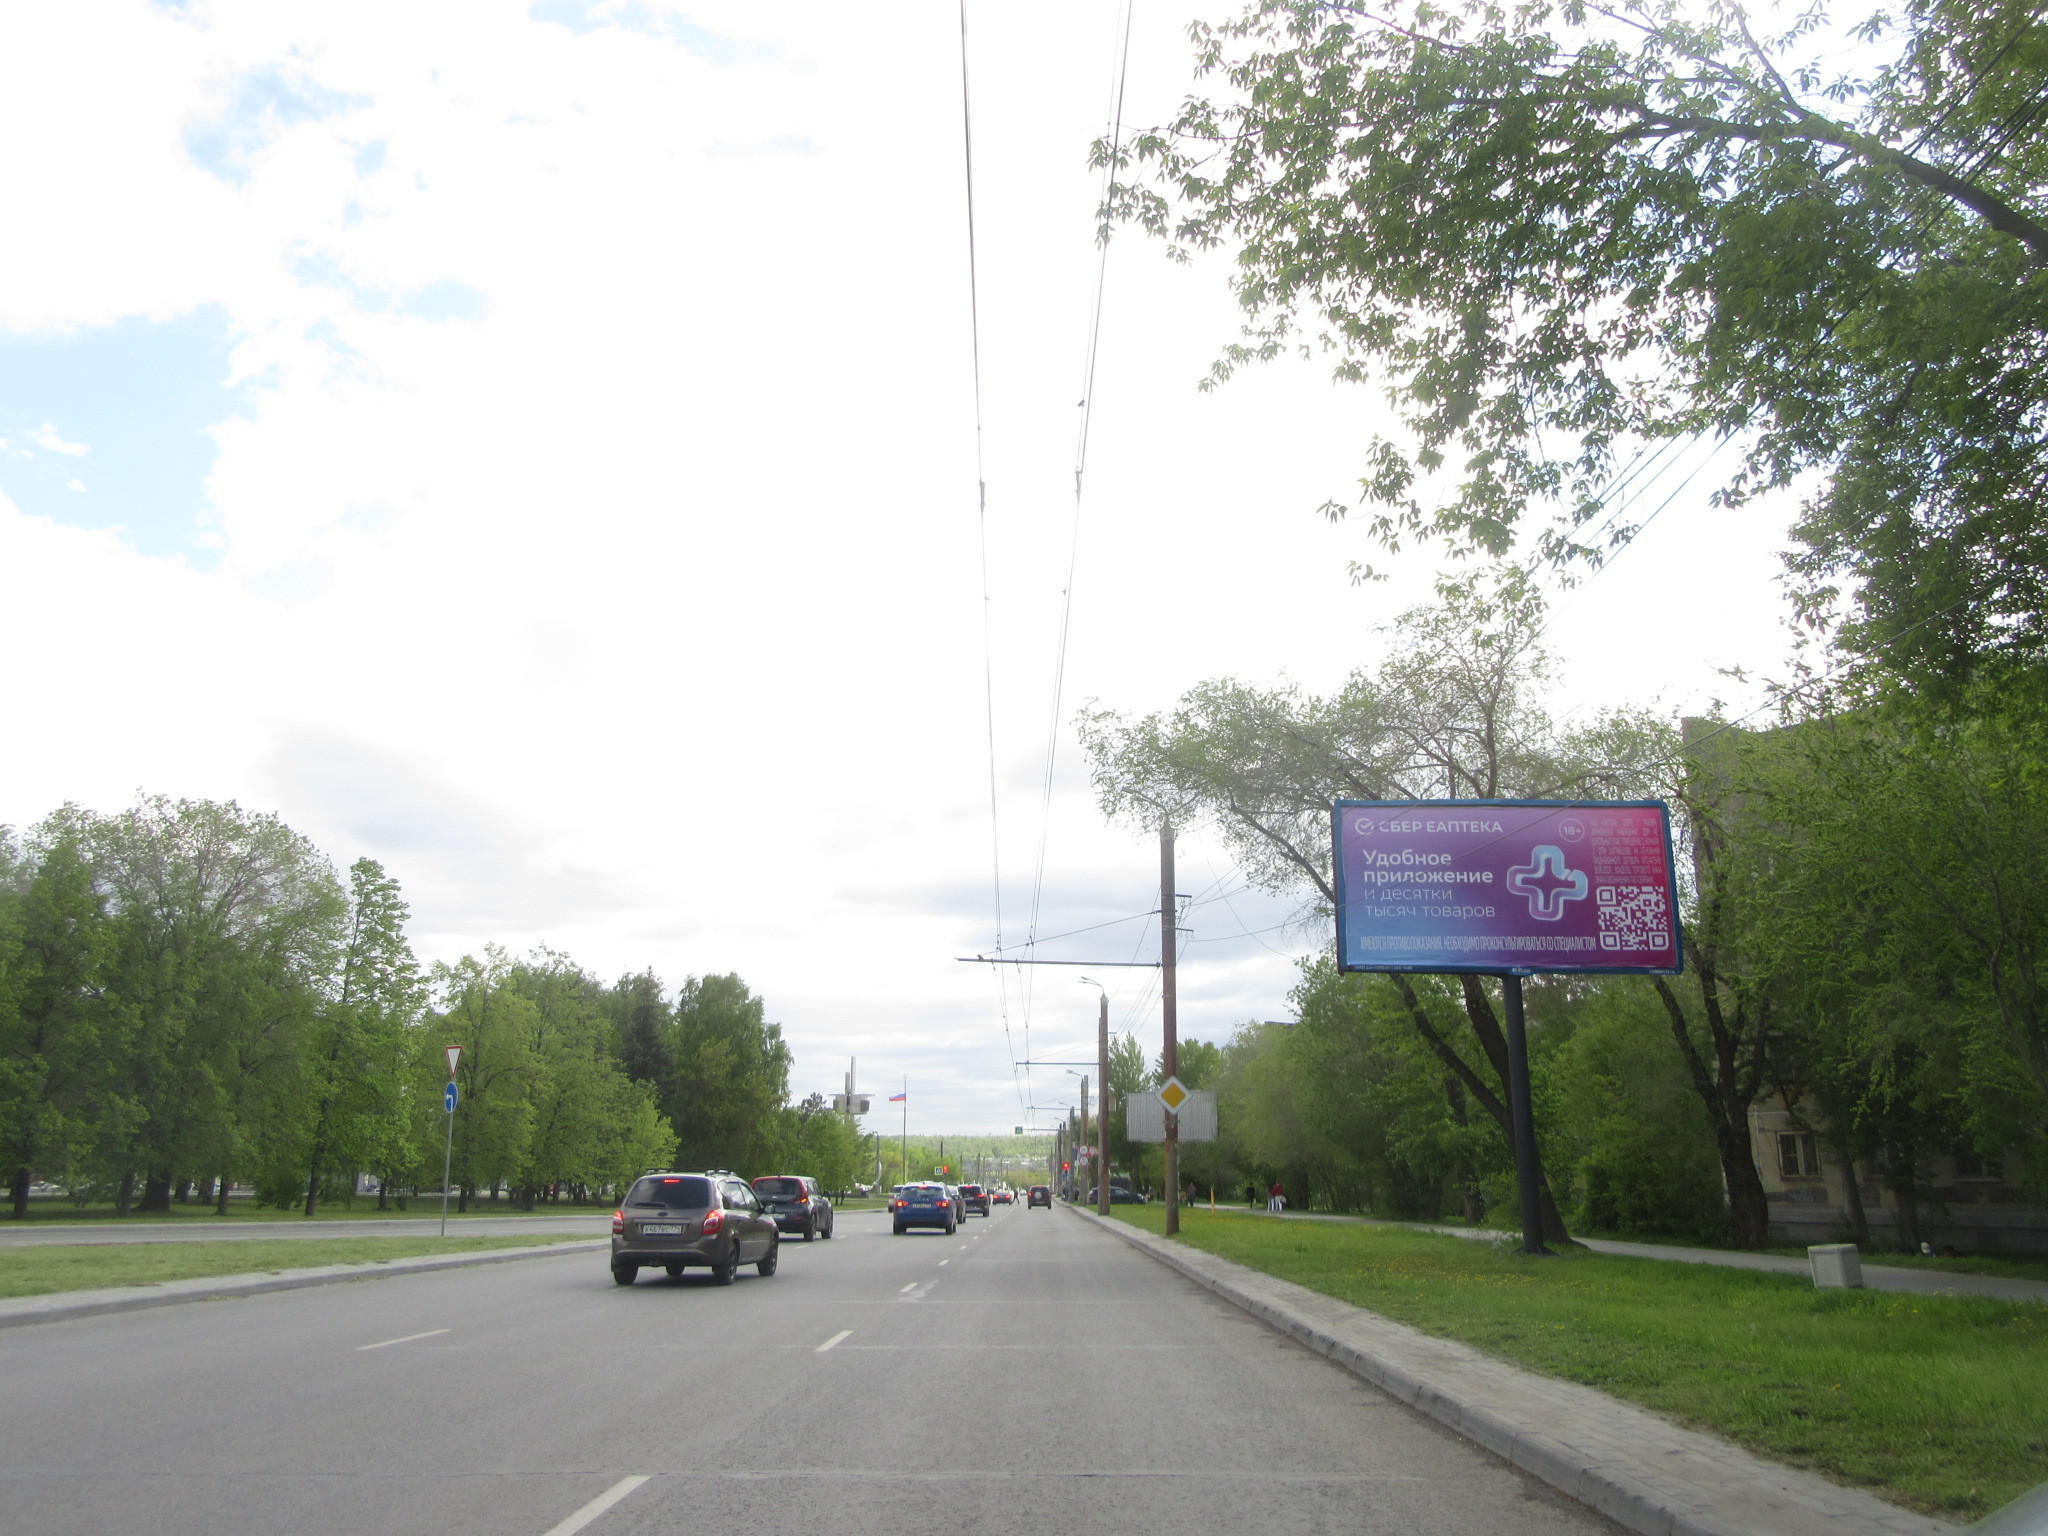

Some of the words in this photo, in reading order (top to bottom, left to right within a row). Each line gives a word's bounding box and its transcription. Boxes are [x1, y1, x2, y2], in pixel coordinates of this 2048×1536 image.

[1379, 821, 1422, 832] СБЕР
[1427, 821, 1503, 833] ЕАПТЕКА
[1564, 826, 1582, 836] 18+
[1362, 849, 1452, 867] Удобное
[1364, 871, 1493, 886] приложение
[1364, 889, 1374, 899] и
[1380, 889, 1452, 902] десятки
[1365, 906, 1416, 917] тысяч
[1422, 906, 1495, 920] товаров
